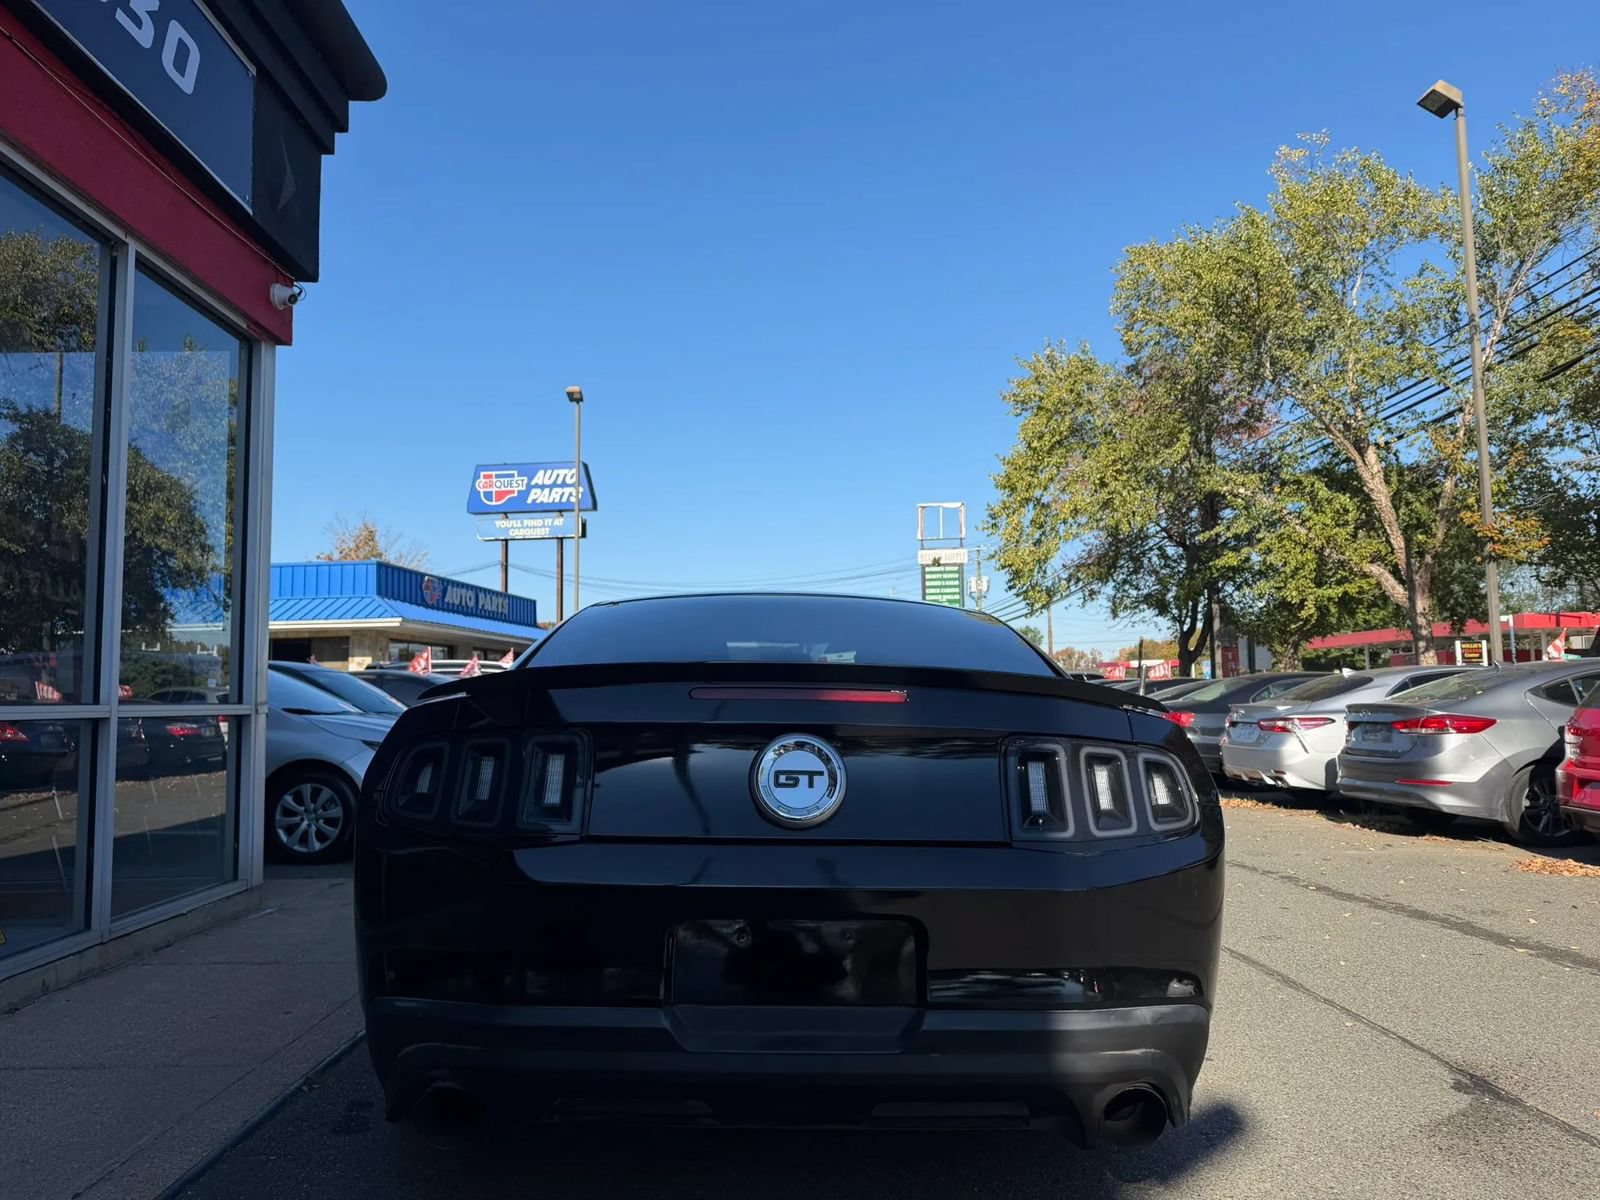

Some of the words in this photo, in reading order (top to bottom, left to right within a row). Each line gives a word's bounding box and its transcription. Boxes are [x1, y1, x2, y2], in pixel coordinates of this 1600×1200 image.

[102, 0, 200, 94] 30
[478, 479, 525, 489] CARQUEST
[531, 469, 576, 485] AUTO
[528, 488, 583, 503] PARTS
[495, 520, 521, 528] YOU'LL
[523, 518, 543, 527] FIND
[544, 518, 553, 527] IT
[553, 517, 564, 526] AT
[444, 585, 474, 608] AUTO
[479, 592, 508, 613] PARTS
[774, 770, 824, 789] GT
